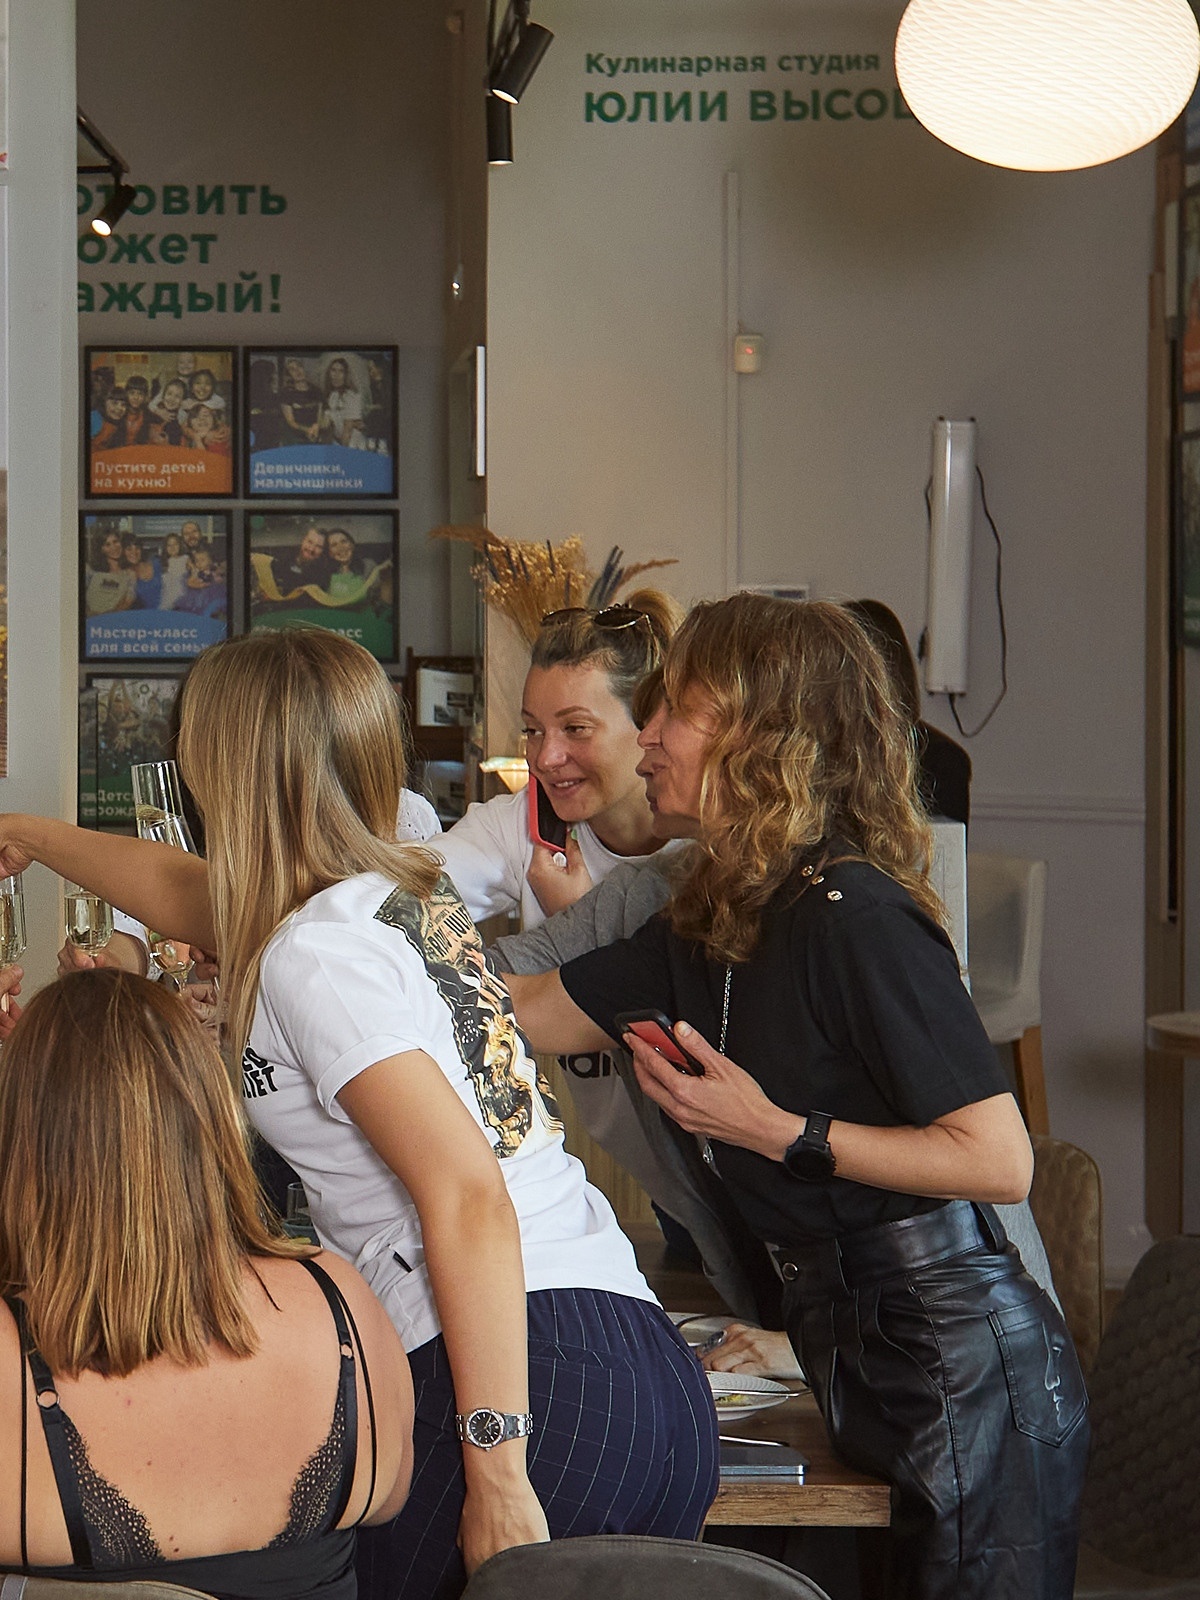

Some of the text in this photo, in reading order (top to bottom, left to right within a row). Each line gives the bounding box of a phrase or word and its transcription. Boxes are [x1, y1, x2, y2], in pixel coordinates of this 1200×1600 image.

[585, 53, 879, 77] Кулинарная студия
[584, 90, 727, 123] ЮЛИИ
[77, 233, 218, 265] ожет
[77, 271, 282, 319] аждый!
[94, 461, 206, 475] Пустите детей
[254, 462, 345, 476] Девичники,
[94, 477, 172, 490] на кухню!
[254, 478, 364, 490] мальчишники
[90, 627, 198, 640] Мастер-класс
[90, 642, 118, 654] для
[124, 641, 159, 653] всей
